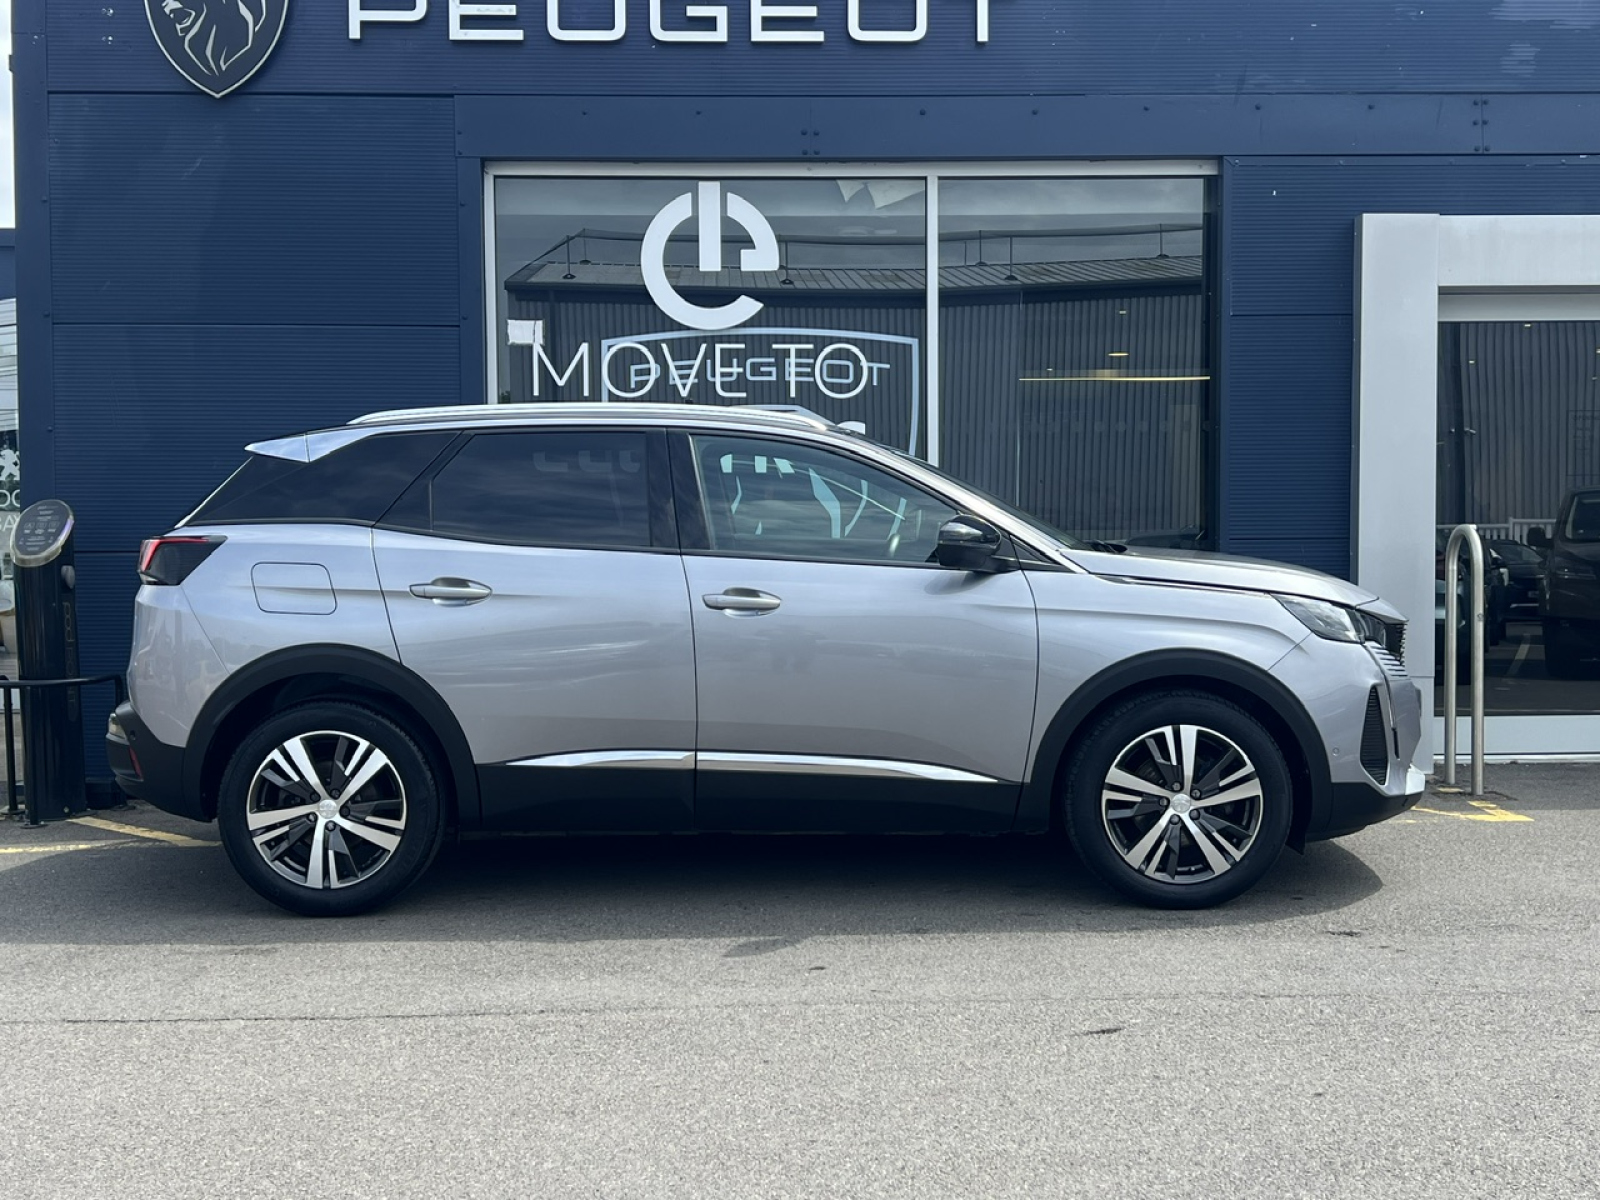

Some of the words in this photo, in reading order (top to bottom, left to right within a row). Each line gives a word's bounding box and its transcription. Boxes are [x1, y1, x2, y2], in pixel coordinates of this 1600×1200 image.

[532, 342, 747, 398] MOVE
[772, 343, 868, 399] TO
[630, 358, 891, 389] PEUGEOT
